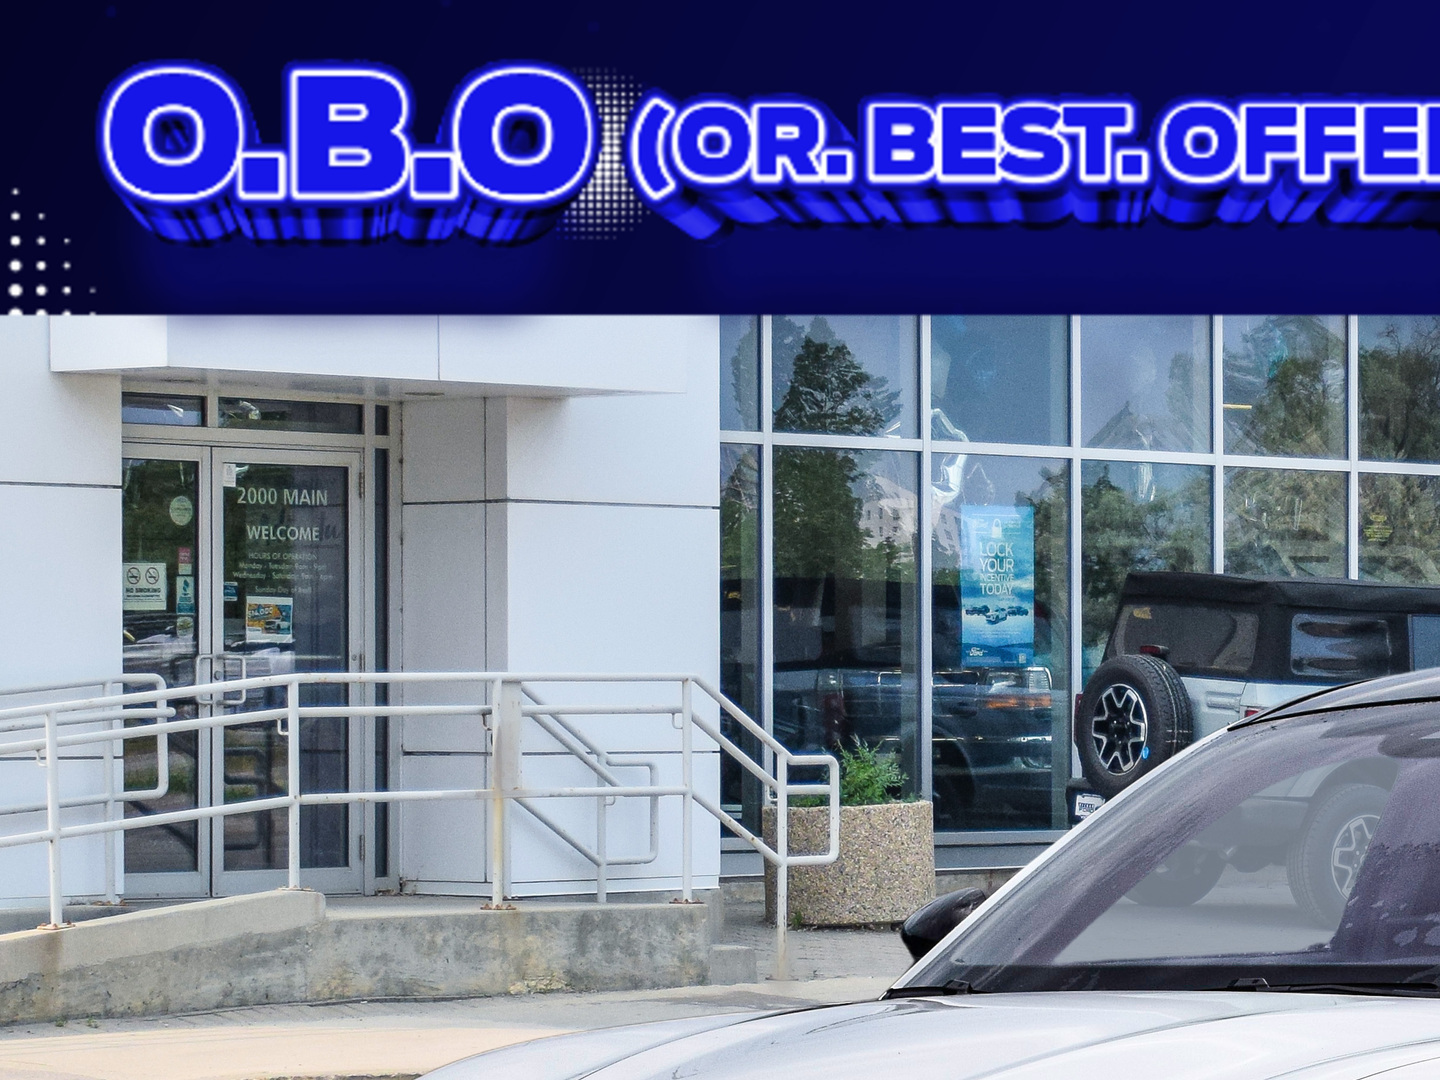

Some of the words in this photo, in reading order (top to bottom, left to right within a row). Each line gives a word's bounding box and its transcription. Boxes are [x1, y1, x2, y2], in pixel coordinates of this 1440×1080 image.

[237, 487, 277, 504] 2000
[283, 488, 328, 506] MAIN
[246, 525, 320, 541] WELCOME
[248, 552, 271, 560] HOURS
[272, 552, 281, 560] OF
[980, 541, 1014, 557] LOCK
[980, 558, 1015, 573] YOUR
[980, 583, 1014, 596] TODAY
